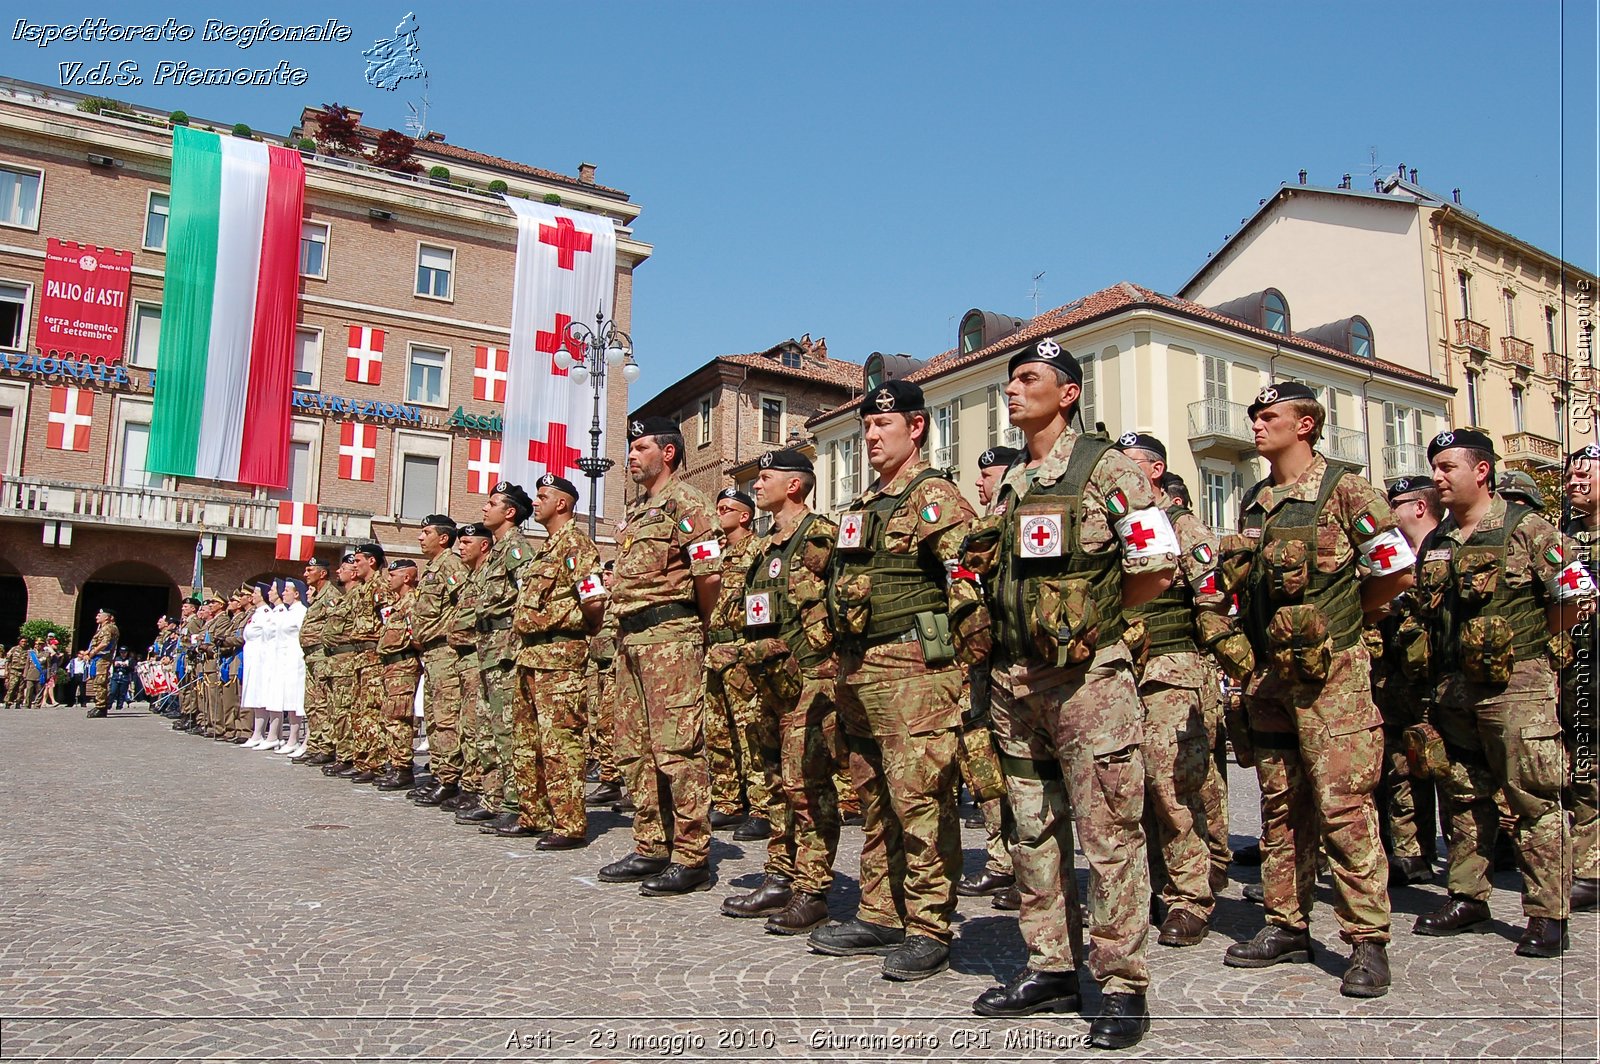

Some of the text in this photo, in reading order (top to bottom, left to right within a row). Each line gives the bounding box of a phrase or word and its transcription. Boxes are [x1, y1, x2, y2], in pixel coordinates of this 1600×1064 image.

[46, 280, 124, 308] PALIO di ASTI
[44, 315, 118, 334] terza domenica
[50, 324, 113, 341] di settembre
